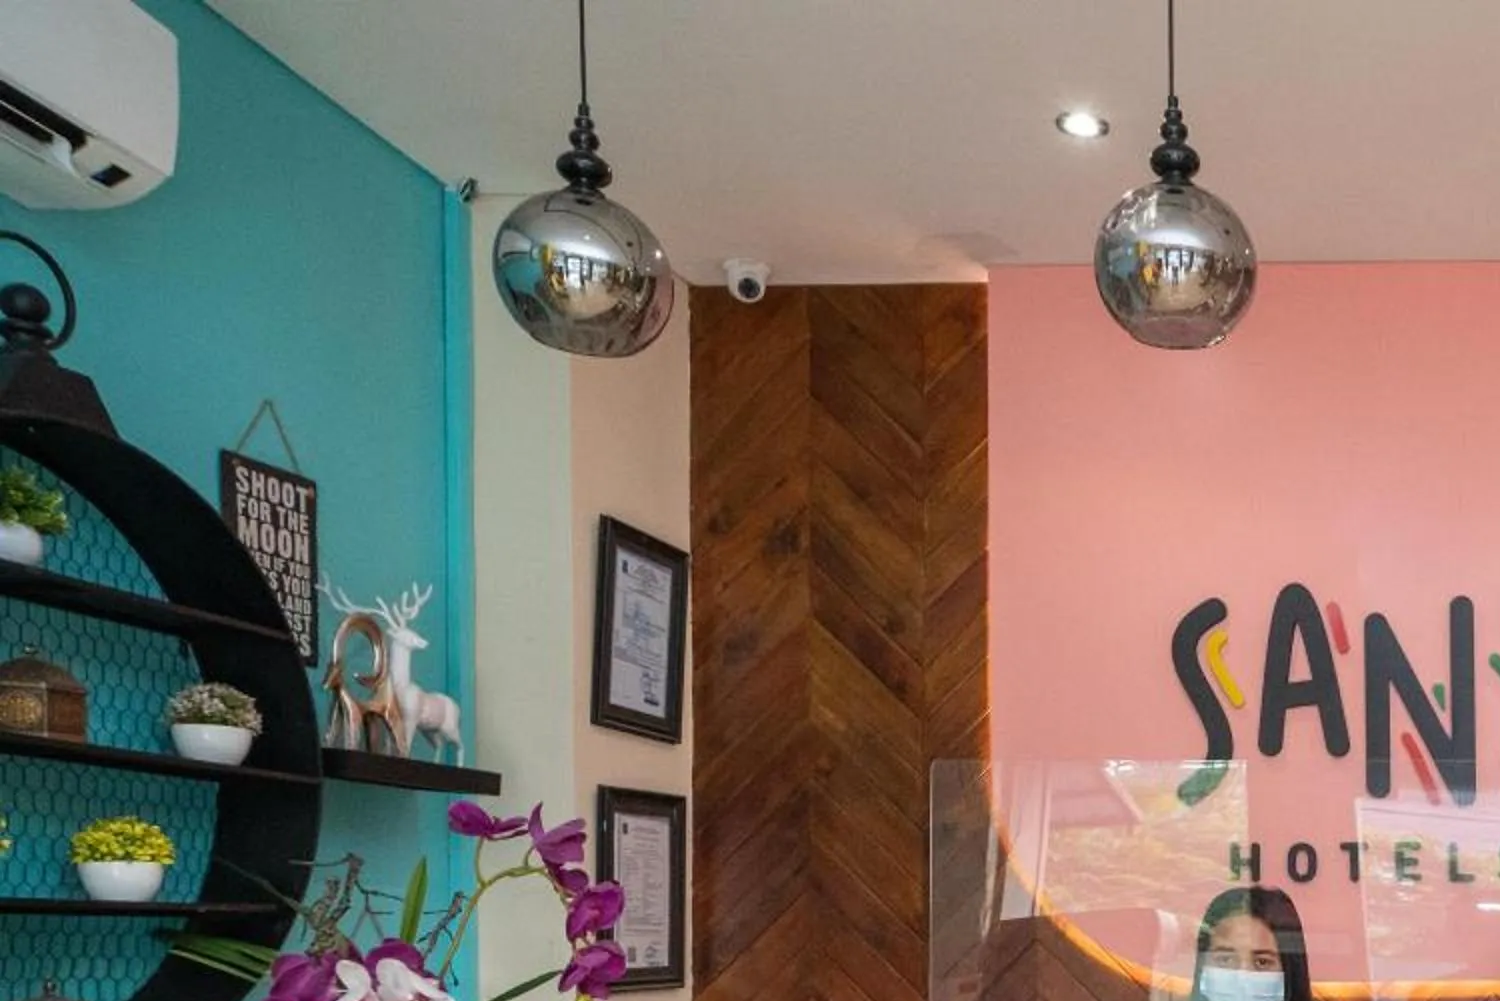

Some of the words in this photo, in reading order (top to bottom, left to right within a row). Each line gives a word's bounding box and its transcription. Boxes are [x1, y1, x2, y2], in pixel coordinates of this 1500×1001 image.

[235, 466, 309, 513] SHOOT
[237, 494, 271, 522] FOR
[277, 506, 309, 535] THE
[237, 515, 309, 565] MOON
[282, 574, 311, 598] YOU
